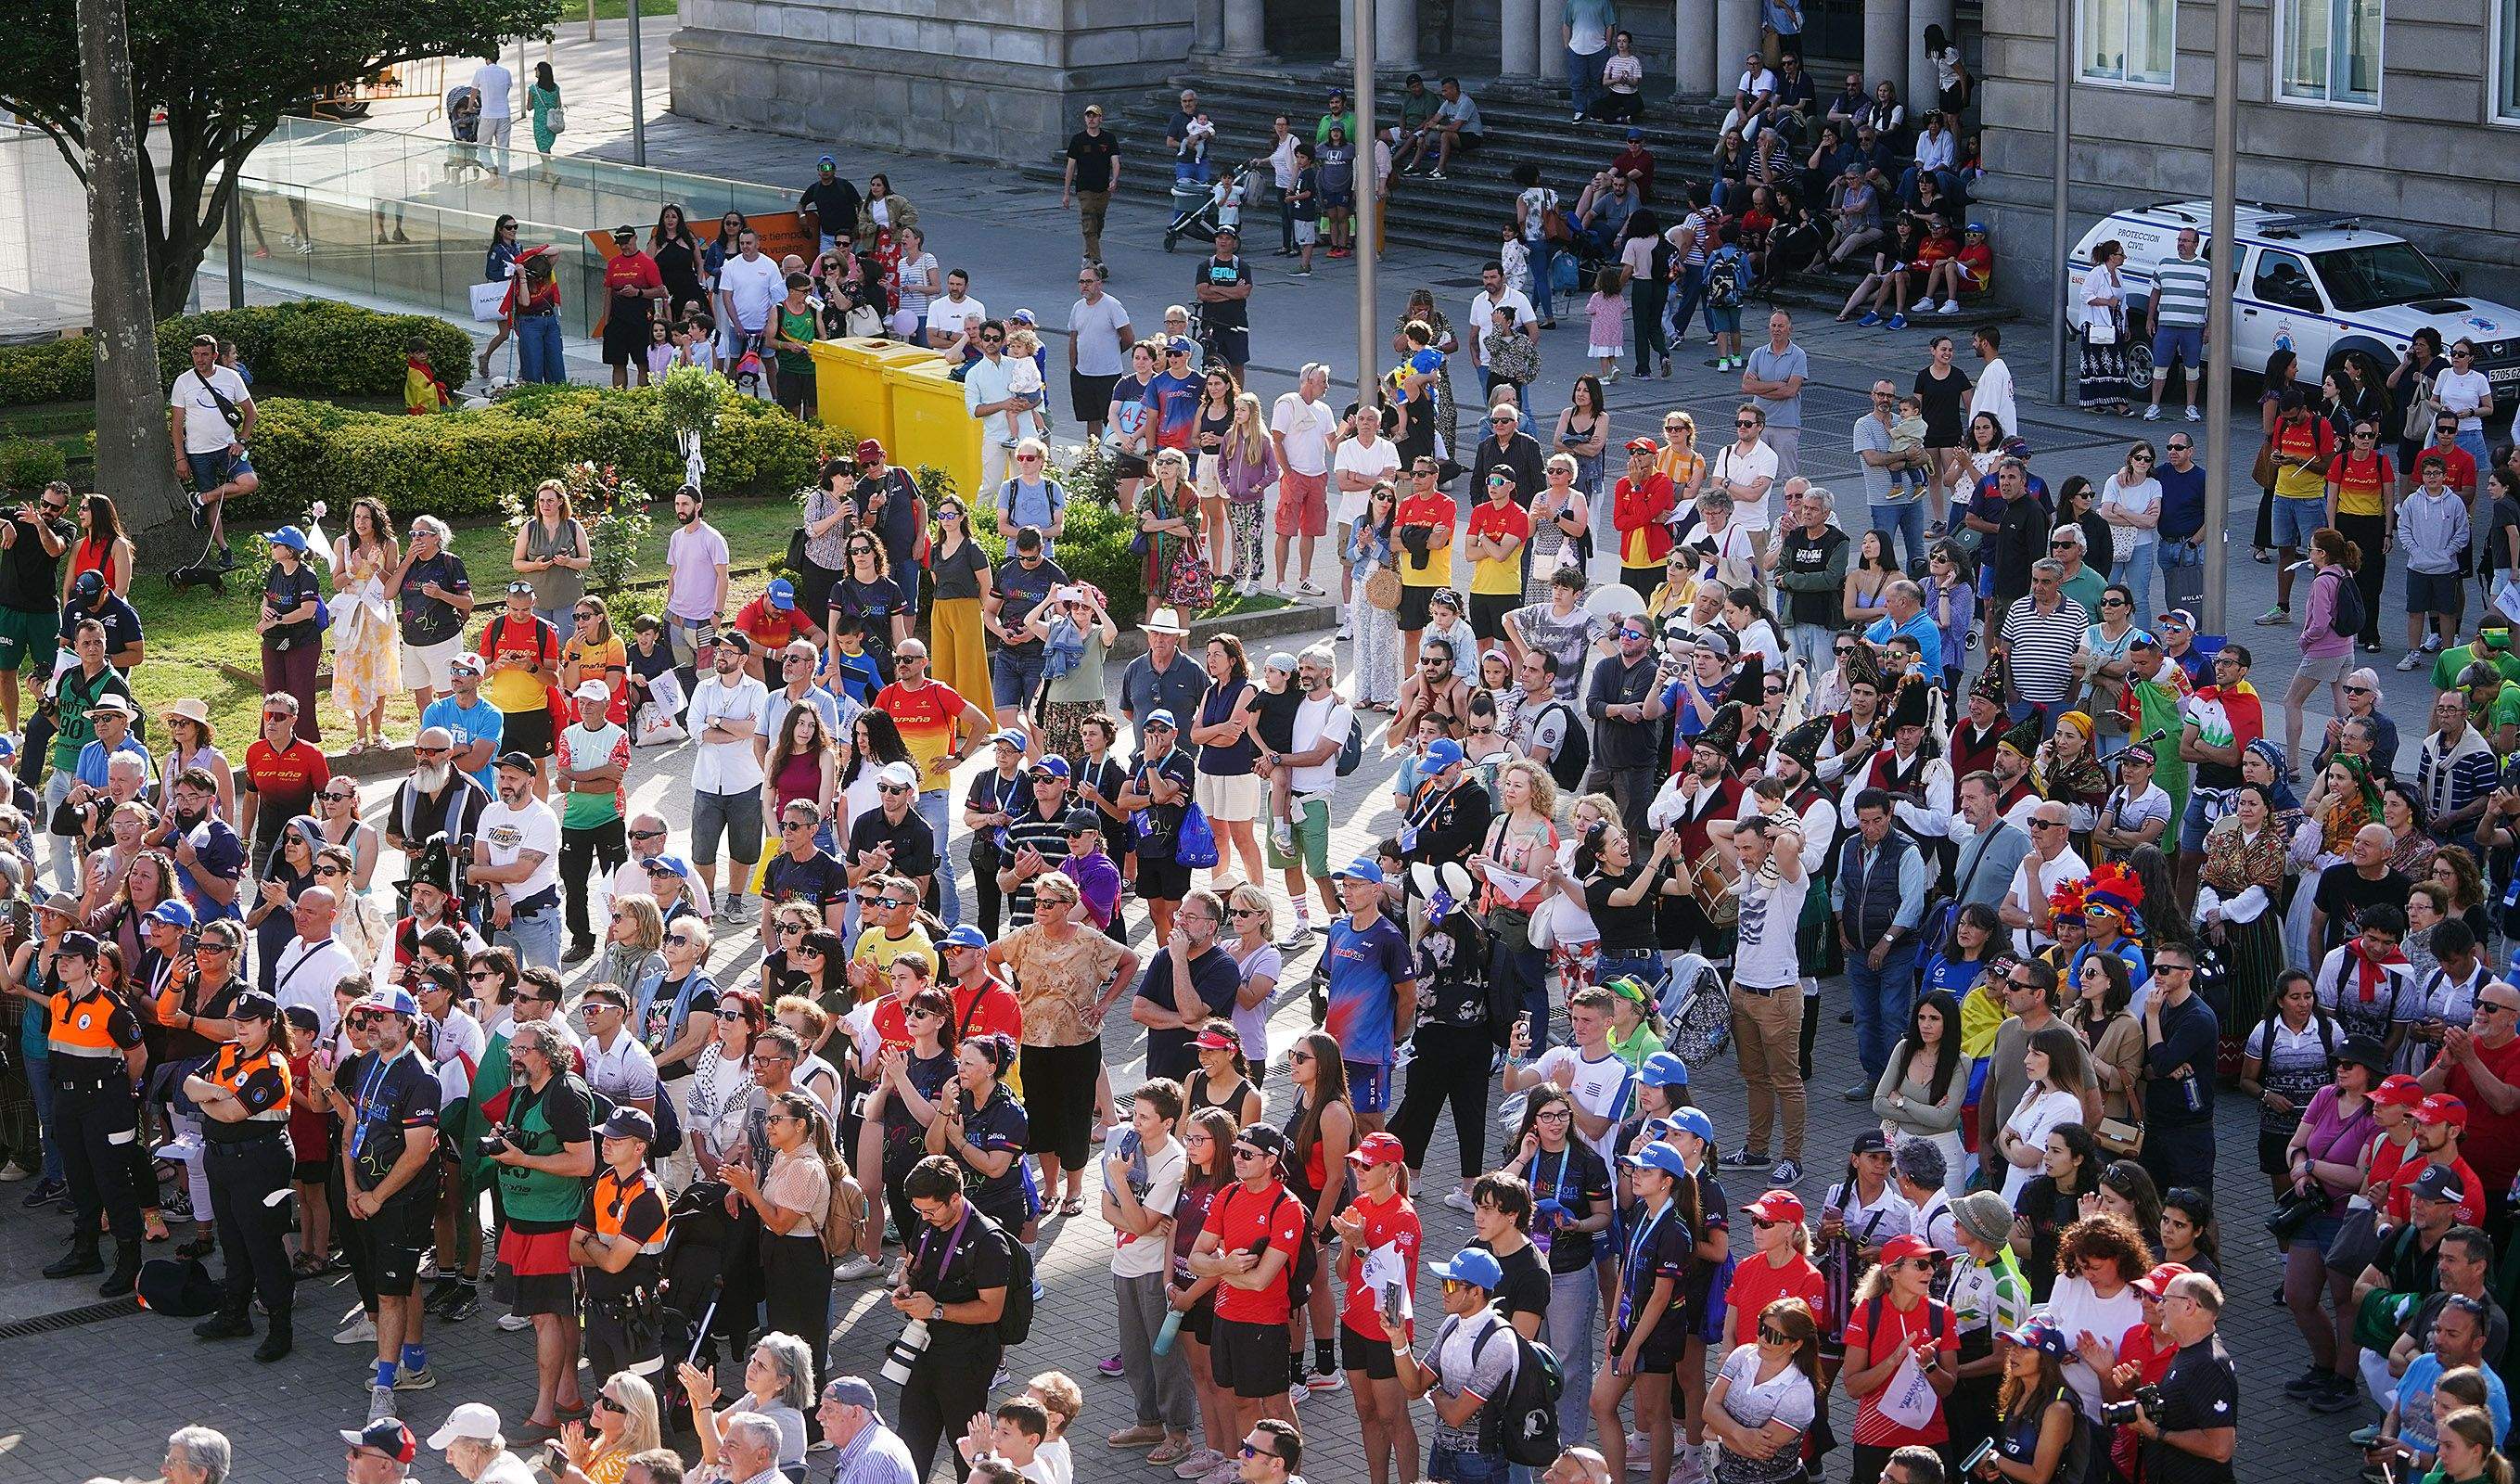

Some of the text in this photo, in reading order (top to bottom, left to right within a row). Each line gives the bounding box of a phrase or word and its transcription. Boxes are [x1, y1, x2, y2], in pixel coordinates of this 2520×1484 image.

[2127, 240, 2145, 251] CIVIL
[2491, 369, 2510, 381] 5705
[2181, 594, 2204, 602] MULAY
[892, 715, 931, 723] españa
[256, 769, 302, 779] españa
[1336, 947, 1364, 962] TEAM USA
[1899, 1369, 1926, 1410] ONTEVEDRA
